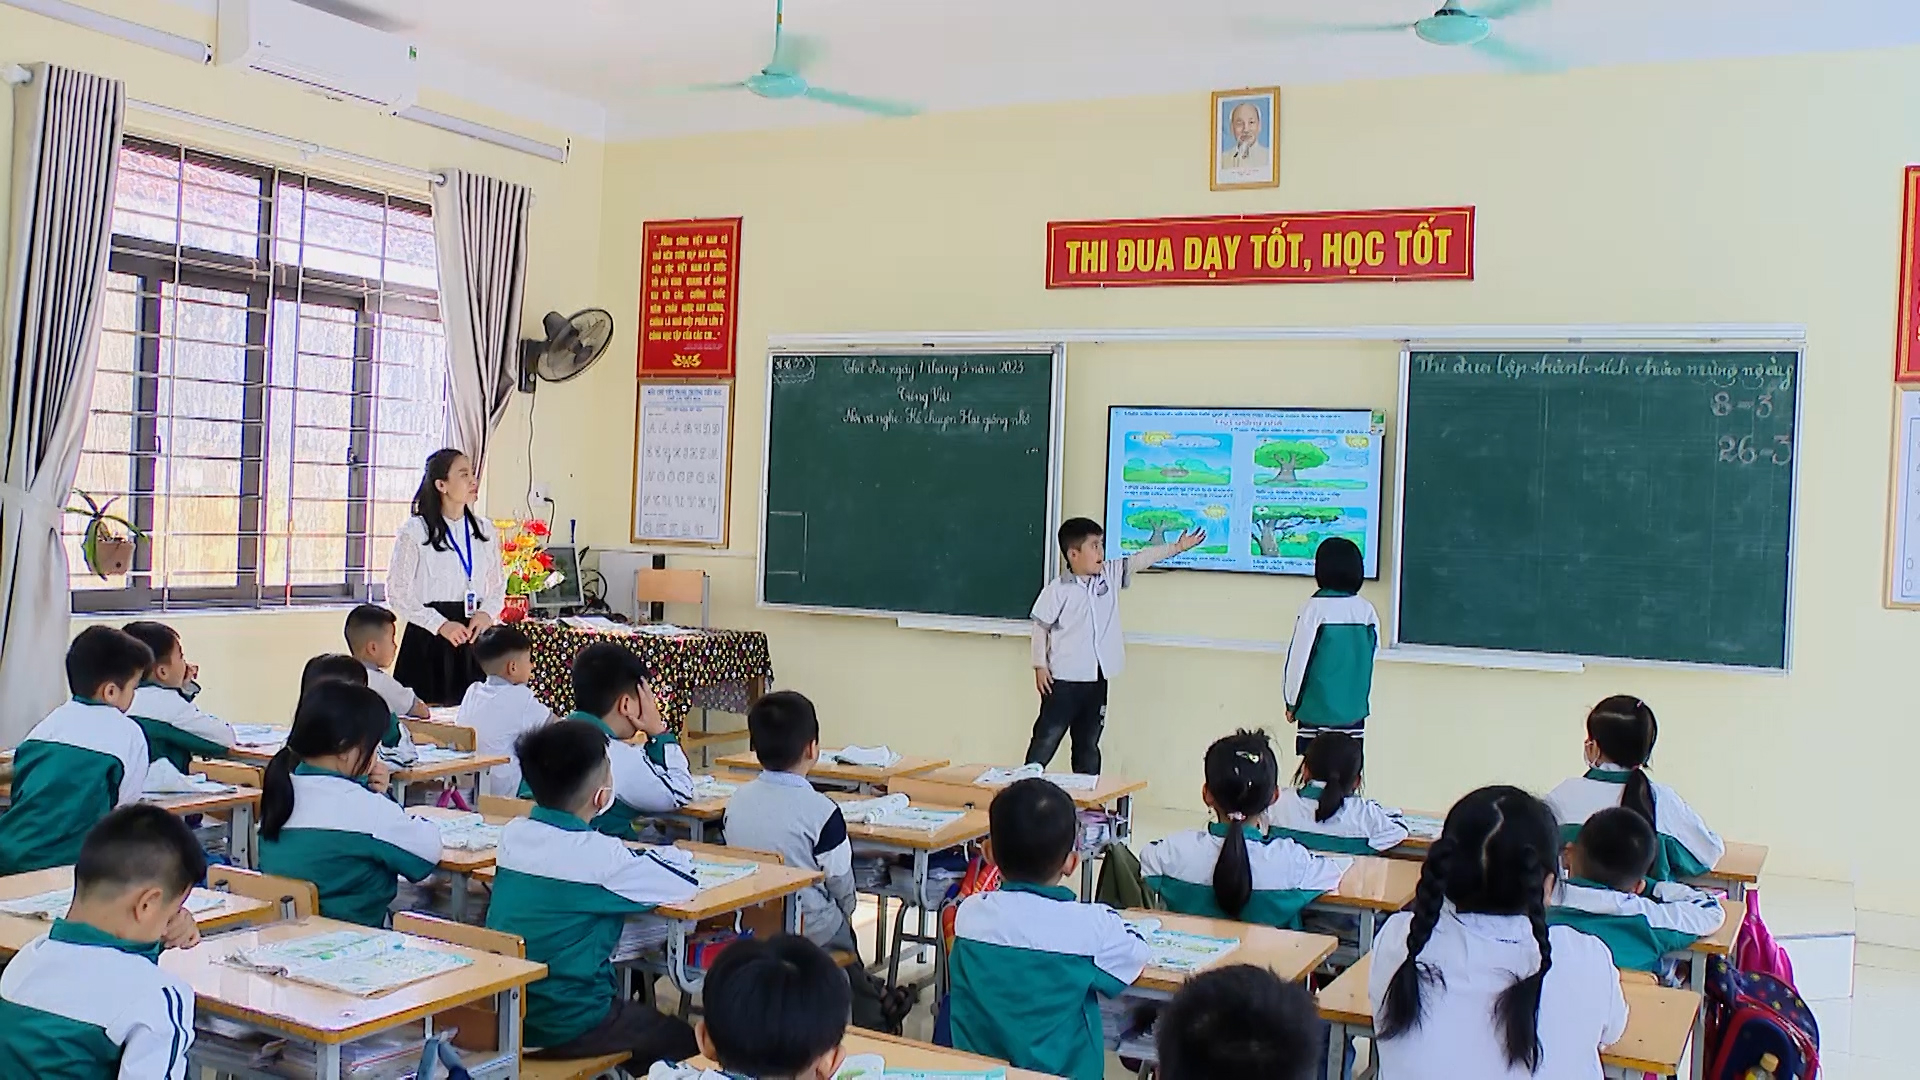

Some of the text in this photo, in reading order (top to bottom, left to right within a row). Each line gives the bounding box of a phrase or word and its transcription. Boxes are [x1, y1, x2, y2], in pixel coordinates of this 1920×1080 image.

[1066, 215, 1452, 278] THI ĐUA DẠY TỐT, HỌC TỐT
[1000, 360, 1026, 375] 2023
[1415, 353, 1794, 391] Thi đua lập thành tích chào mừng ngày
[1718, 435, 1792, 465] 26-3
